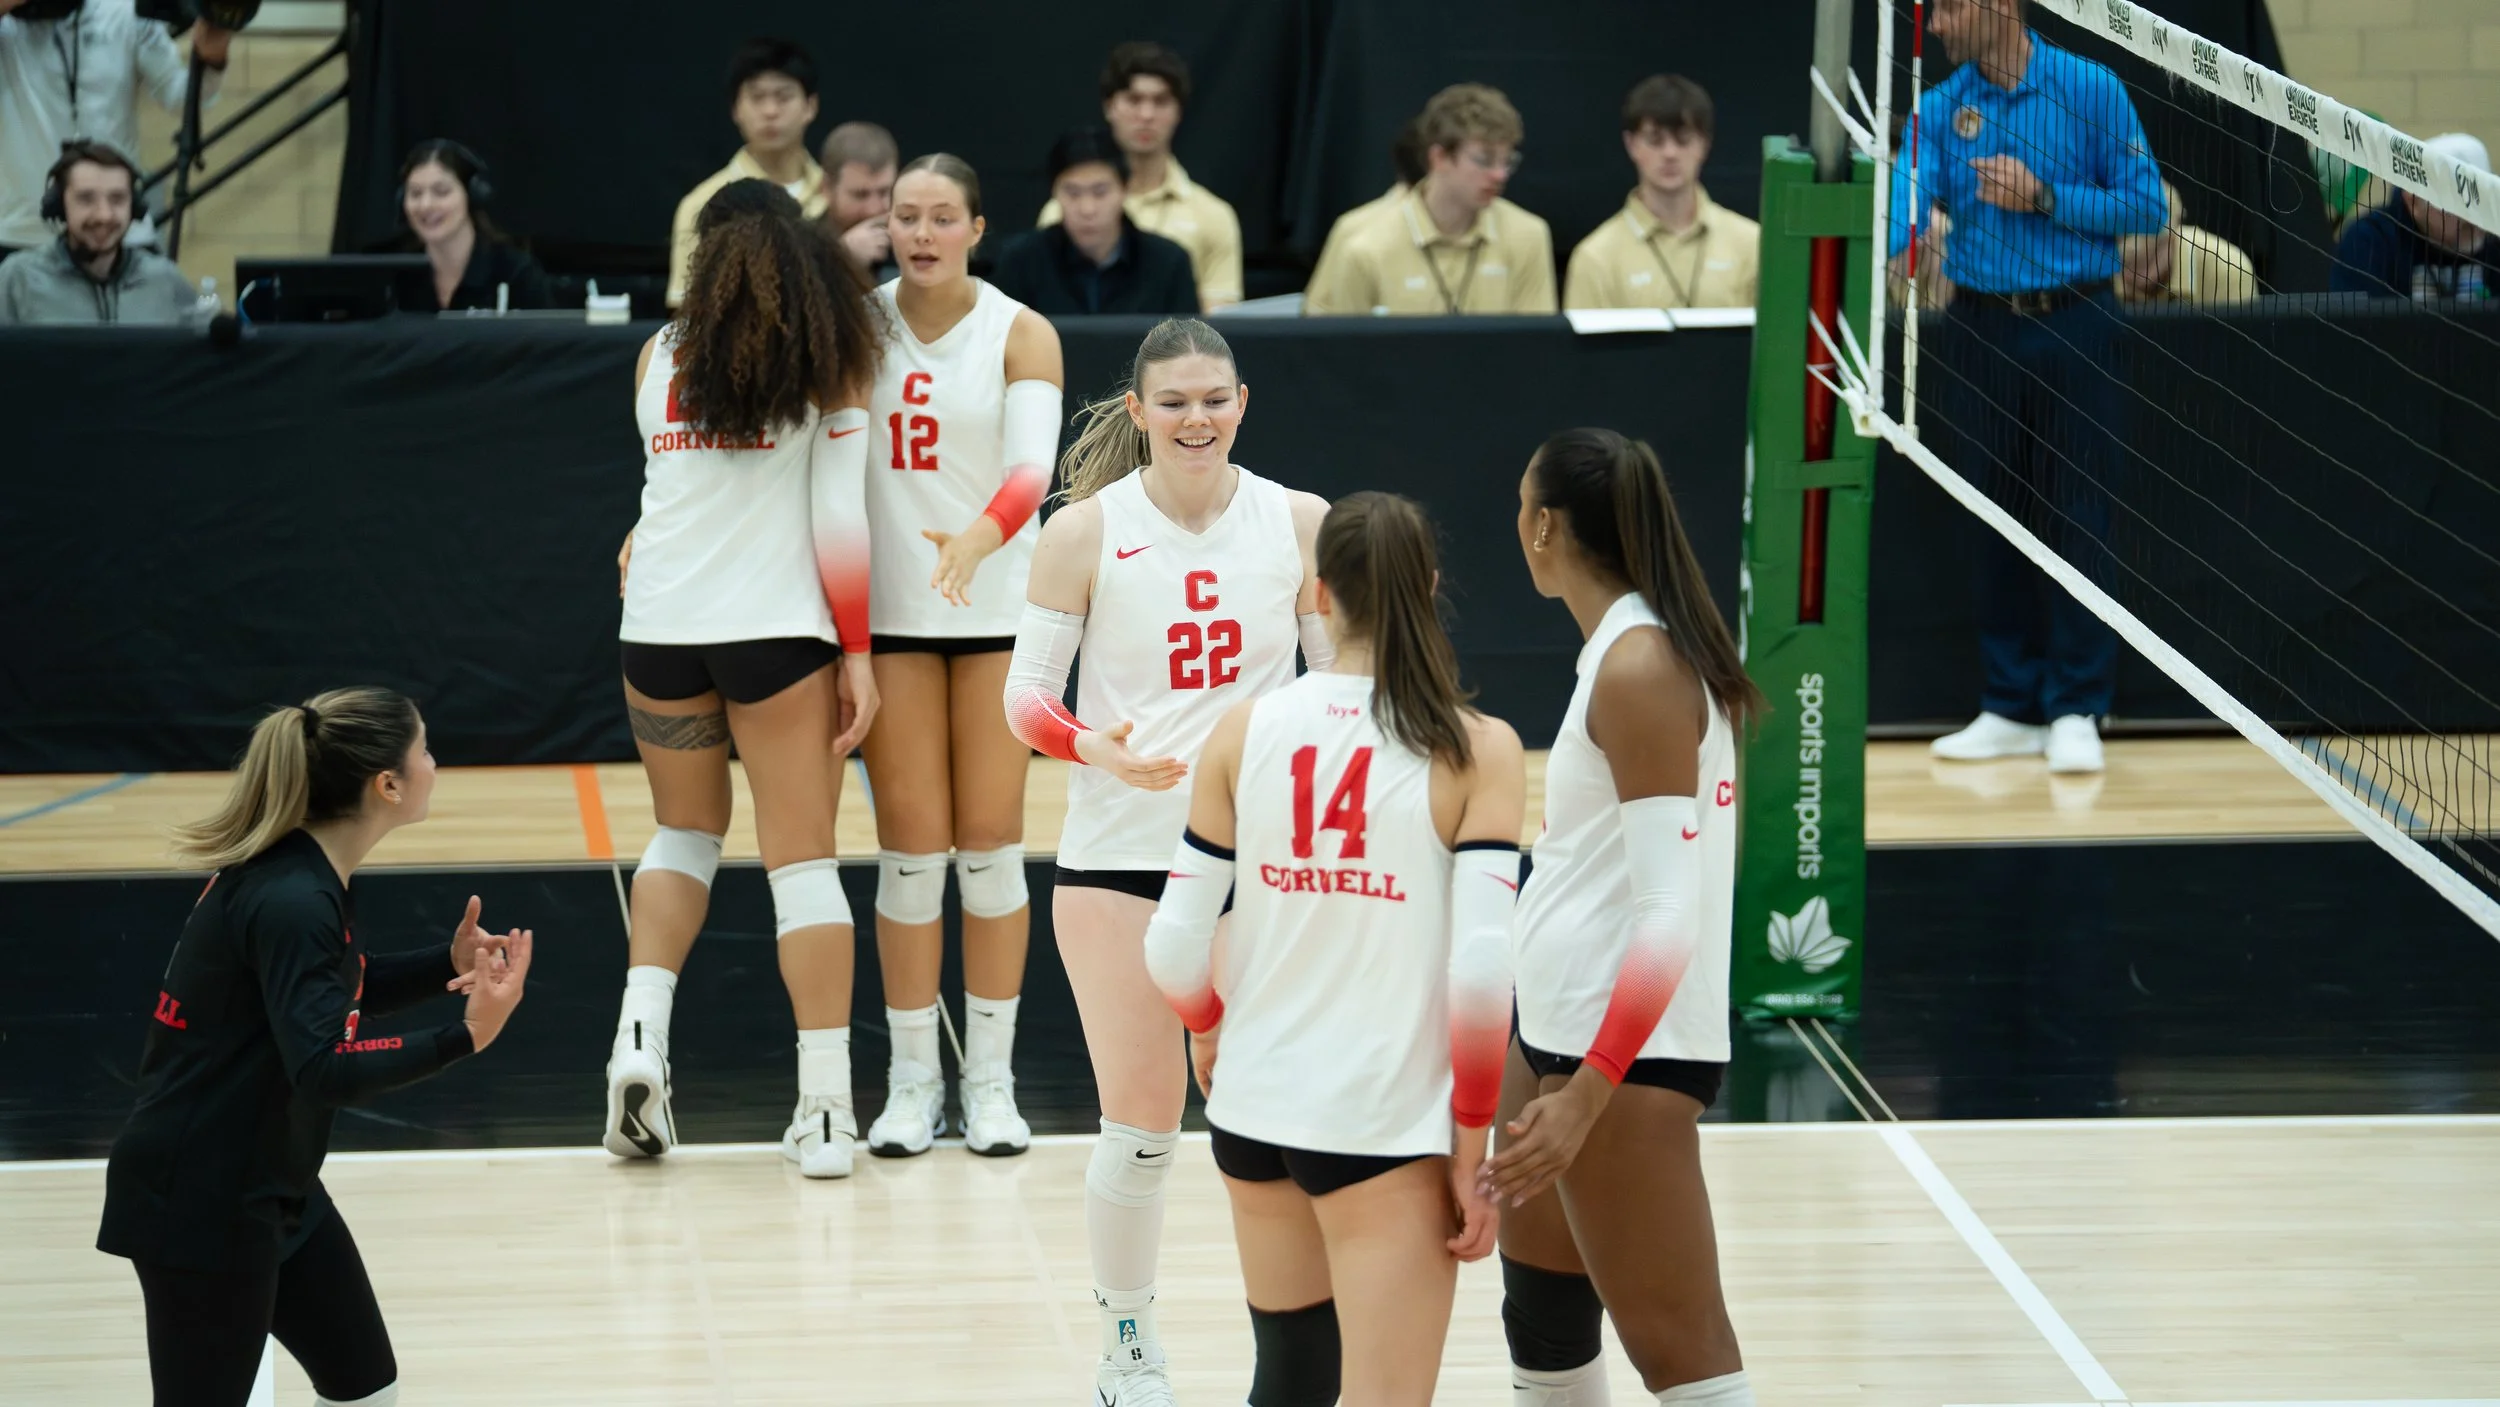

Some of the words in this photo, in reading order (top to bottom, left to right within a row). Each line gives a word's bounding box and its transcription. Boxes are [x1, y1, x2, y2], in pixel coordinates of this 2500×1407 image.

[902, 372, 933, 406] C
[889, 412, 939, 471] 12
[1184, 569, 1220, 612] C
[1167, 619, 1242, 690] 22
[1796, 673, 1827, 765] sports
[1290, 744, 1374, 859] 14
[1793, 768, 1824, 880] imports
